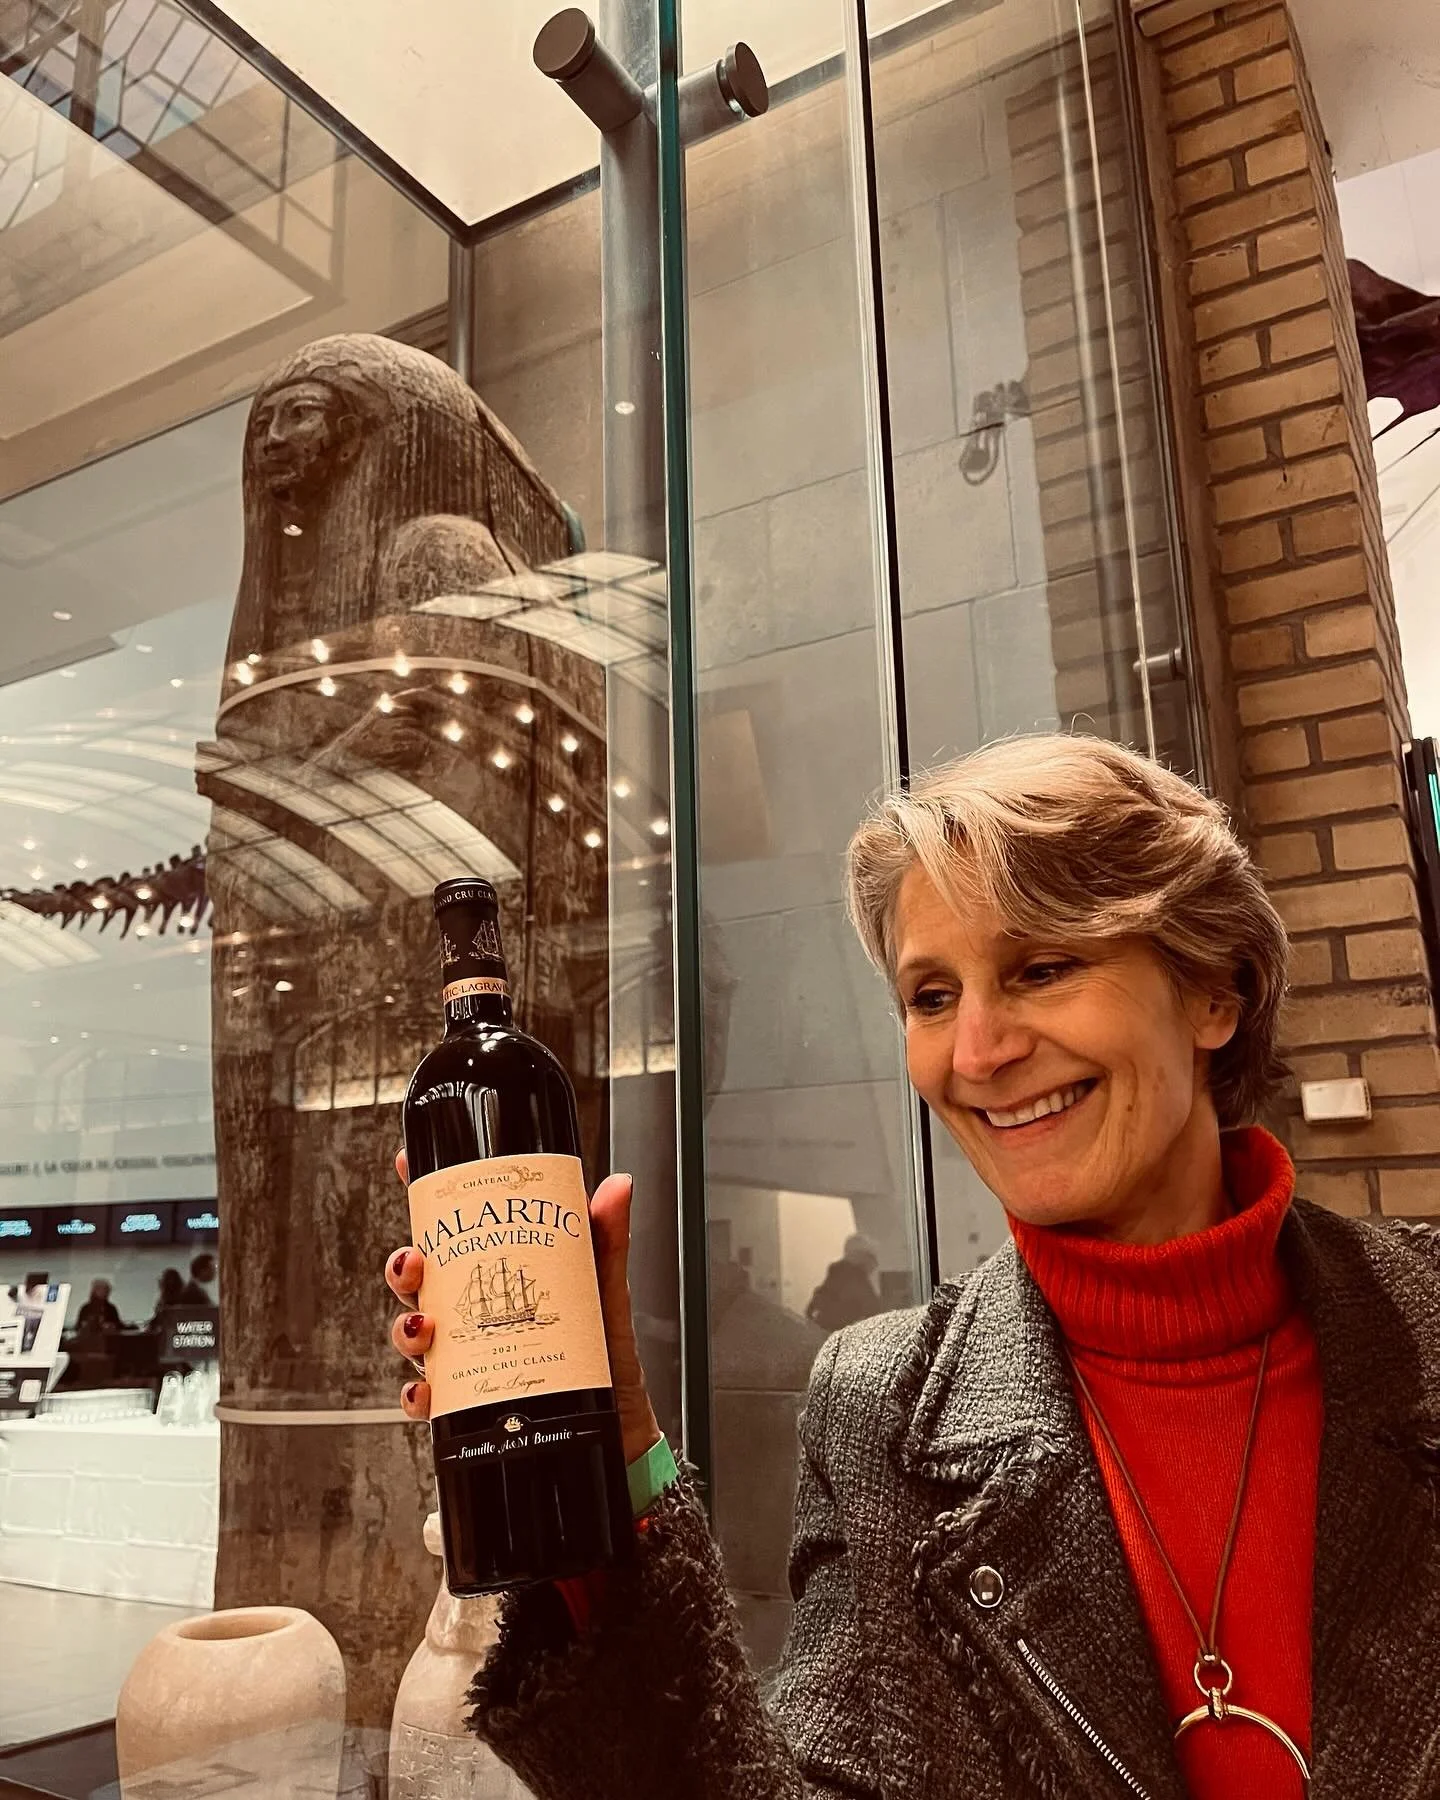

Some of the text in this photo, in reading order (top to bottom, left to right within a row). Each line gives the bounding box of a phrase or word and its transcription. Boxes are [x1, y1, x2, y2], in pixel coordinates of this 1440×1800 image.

[454, 890, 474, 900] CRU
[417, 1198, 581, 1259] MALARTIC
[436, 1226, 556, 1267] LAGRAVIÈRE
[176, 1321, 214, 1334] WATER
[172, 1334, 216, 1349] STATION
[491, 1345, 518, 1355] 2021
[451, 1352, 567, 1381] GRAND CRU CLASSÉ
[459, 1441, 496, 1460] Famille
[533, 1429, 573, 1445] Bonnie
